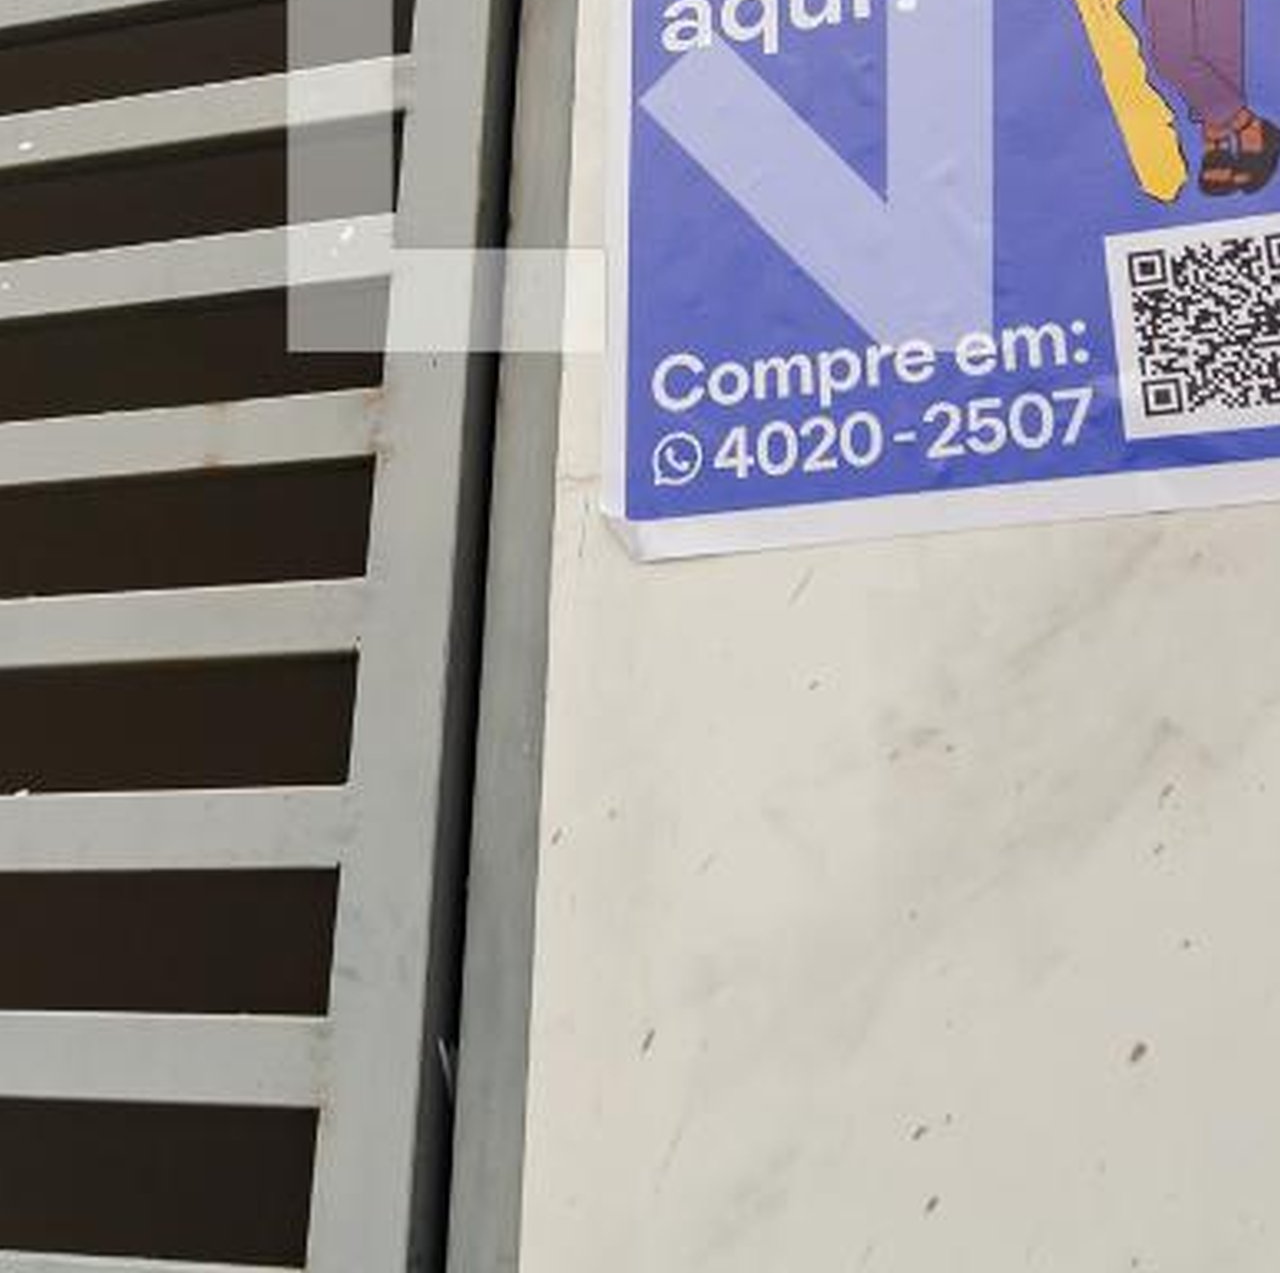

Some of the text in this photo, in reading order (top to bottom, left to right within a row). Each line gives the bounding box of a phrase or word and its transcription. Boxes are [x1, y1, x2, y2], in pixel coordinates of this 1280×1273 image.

[651, 315, 1091, 414] Compre em:
[713, 387, 1094, 481] 4020-2507
